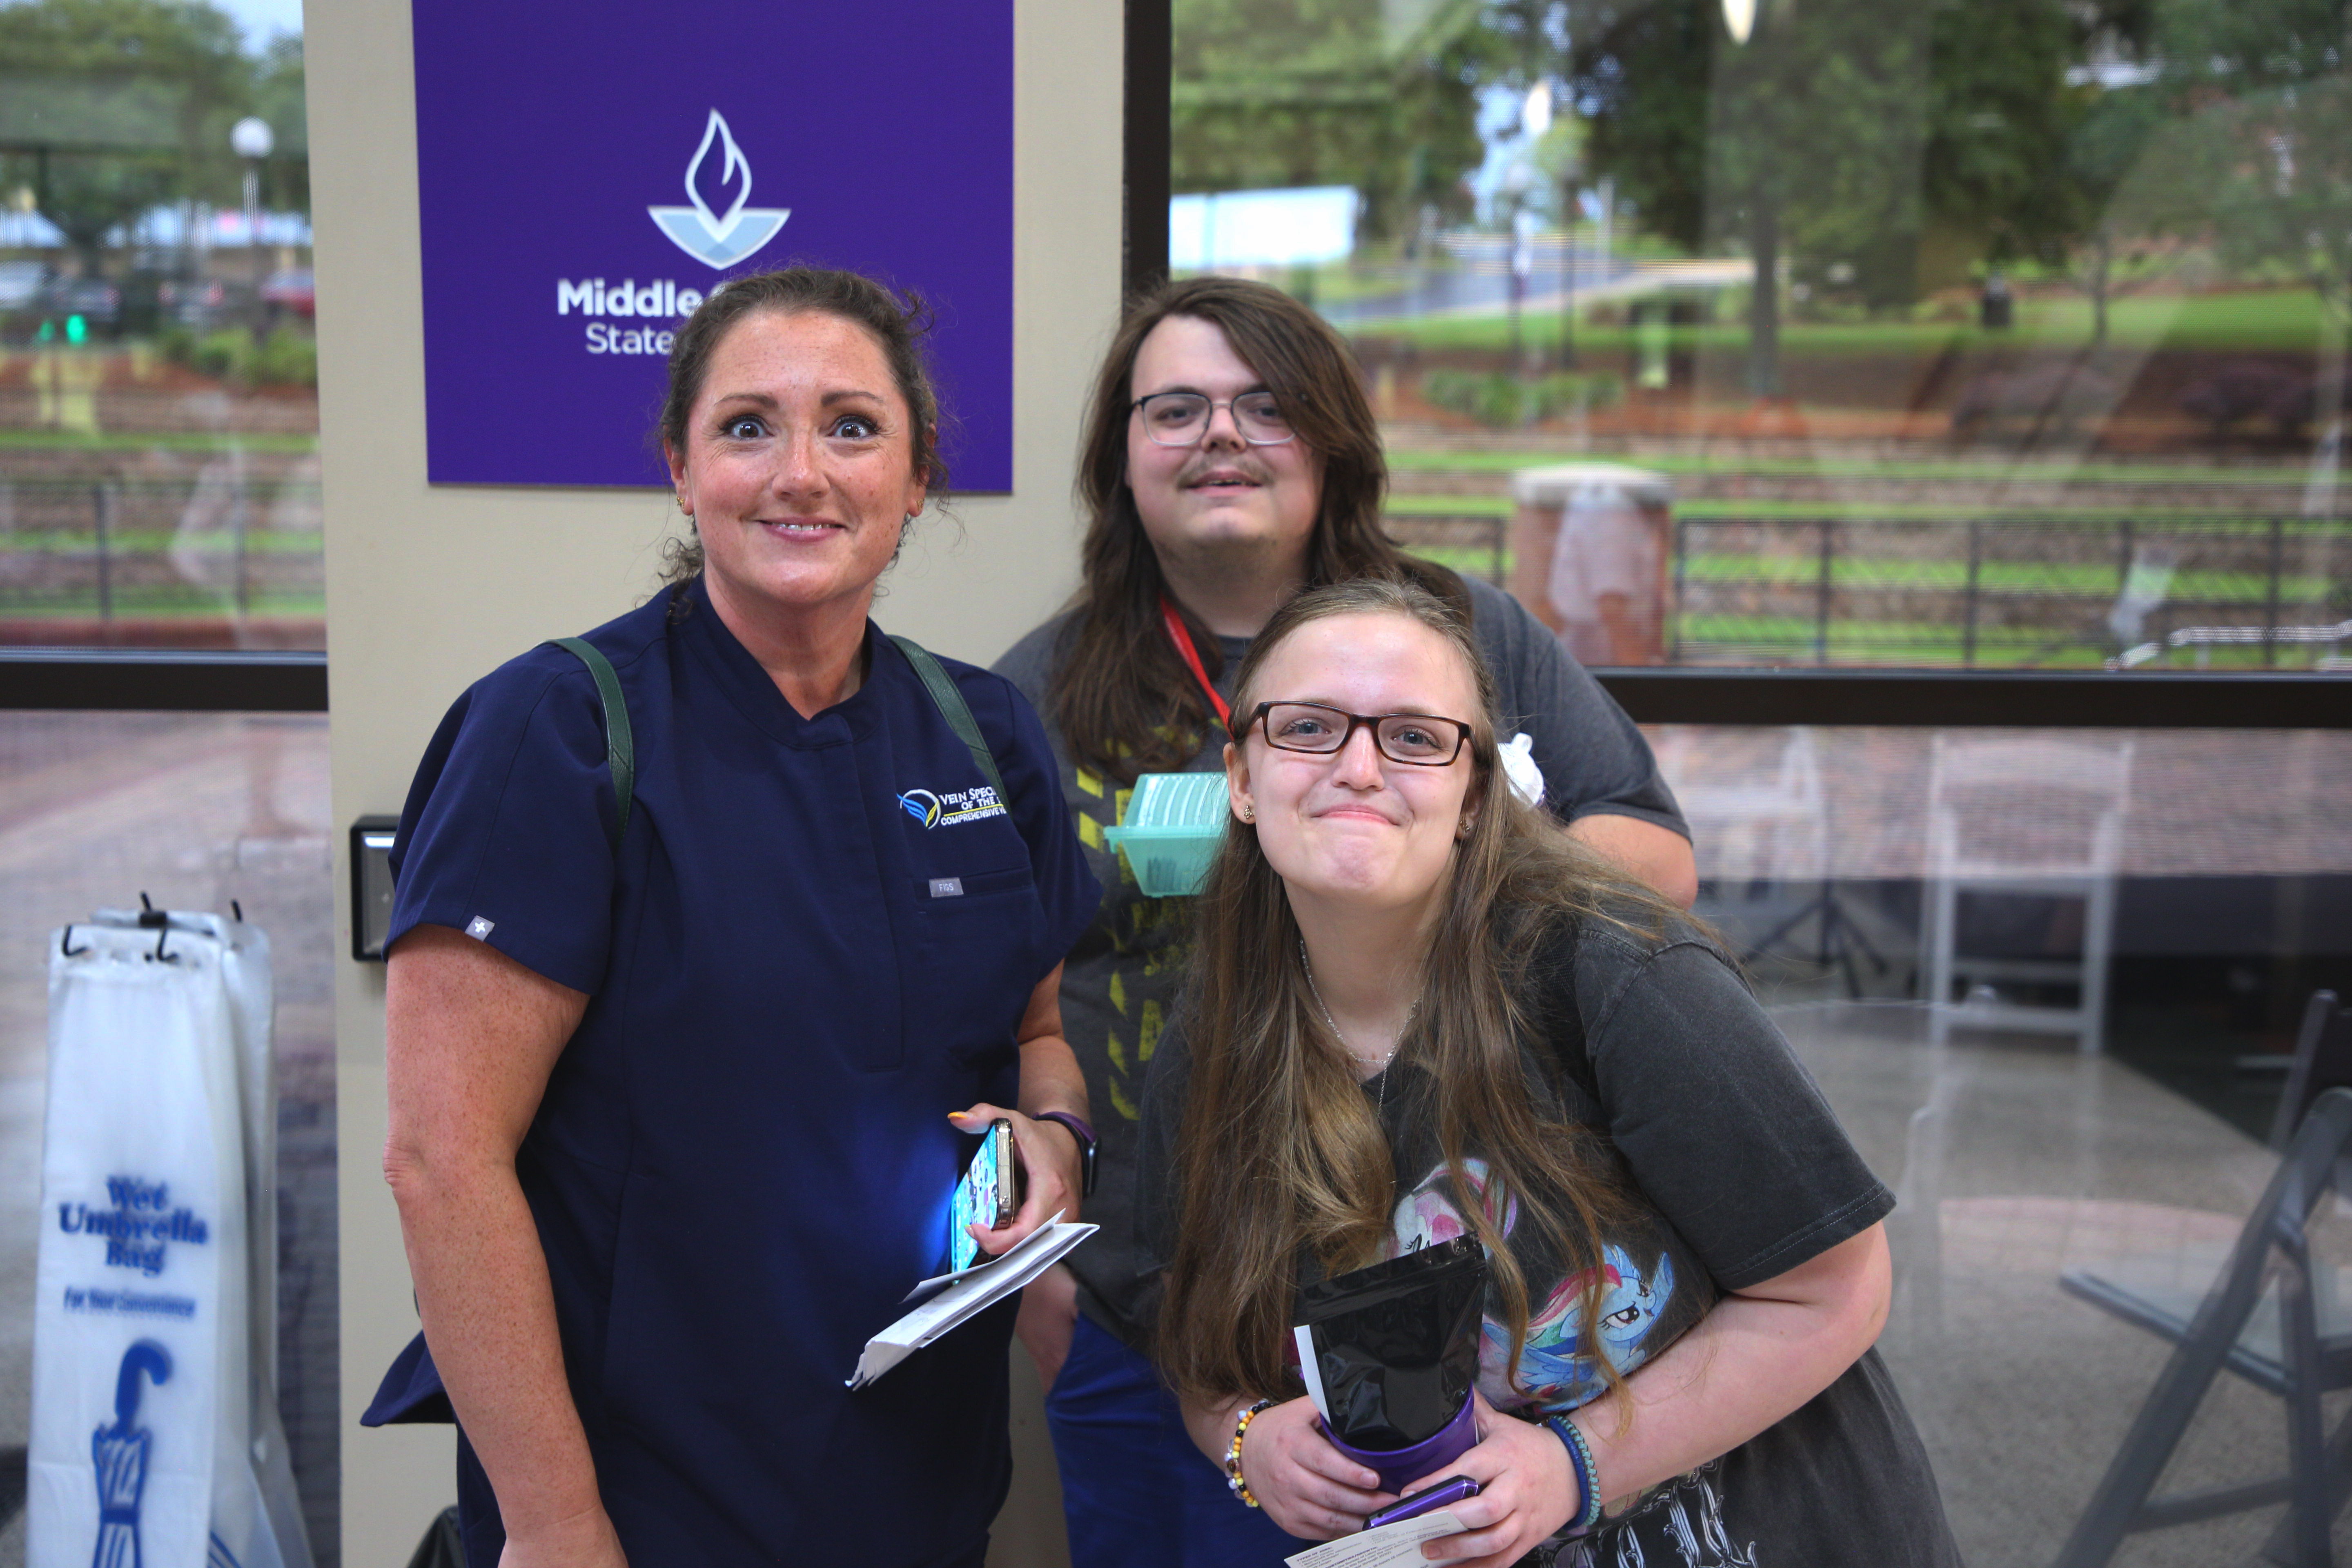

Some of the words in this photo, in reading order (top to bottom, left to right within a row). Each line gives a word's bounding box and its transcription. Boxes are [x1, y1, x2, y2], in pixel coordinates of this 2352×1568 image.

[557, 278, 703, 318] Middle
[586, 322, 675, 355] State
[939, 791, 967, 805] VEIN
[961, 801, 973, 810] OF
[977, 796, 995, 807] THE
[940, 806, 1000, 826] COMPREHENSIVE
[939, 883, 954, 892] FIGS
[106, 1174, 168, 1211] Wet
[59, 1203, 209, 1245] Umbrella
